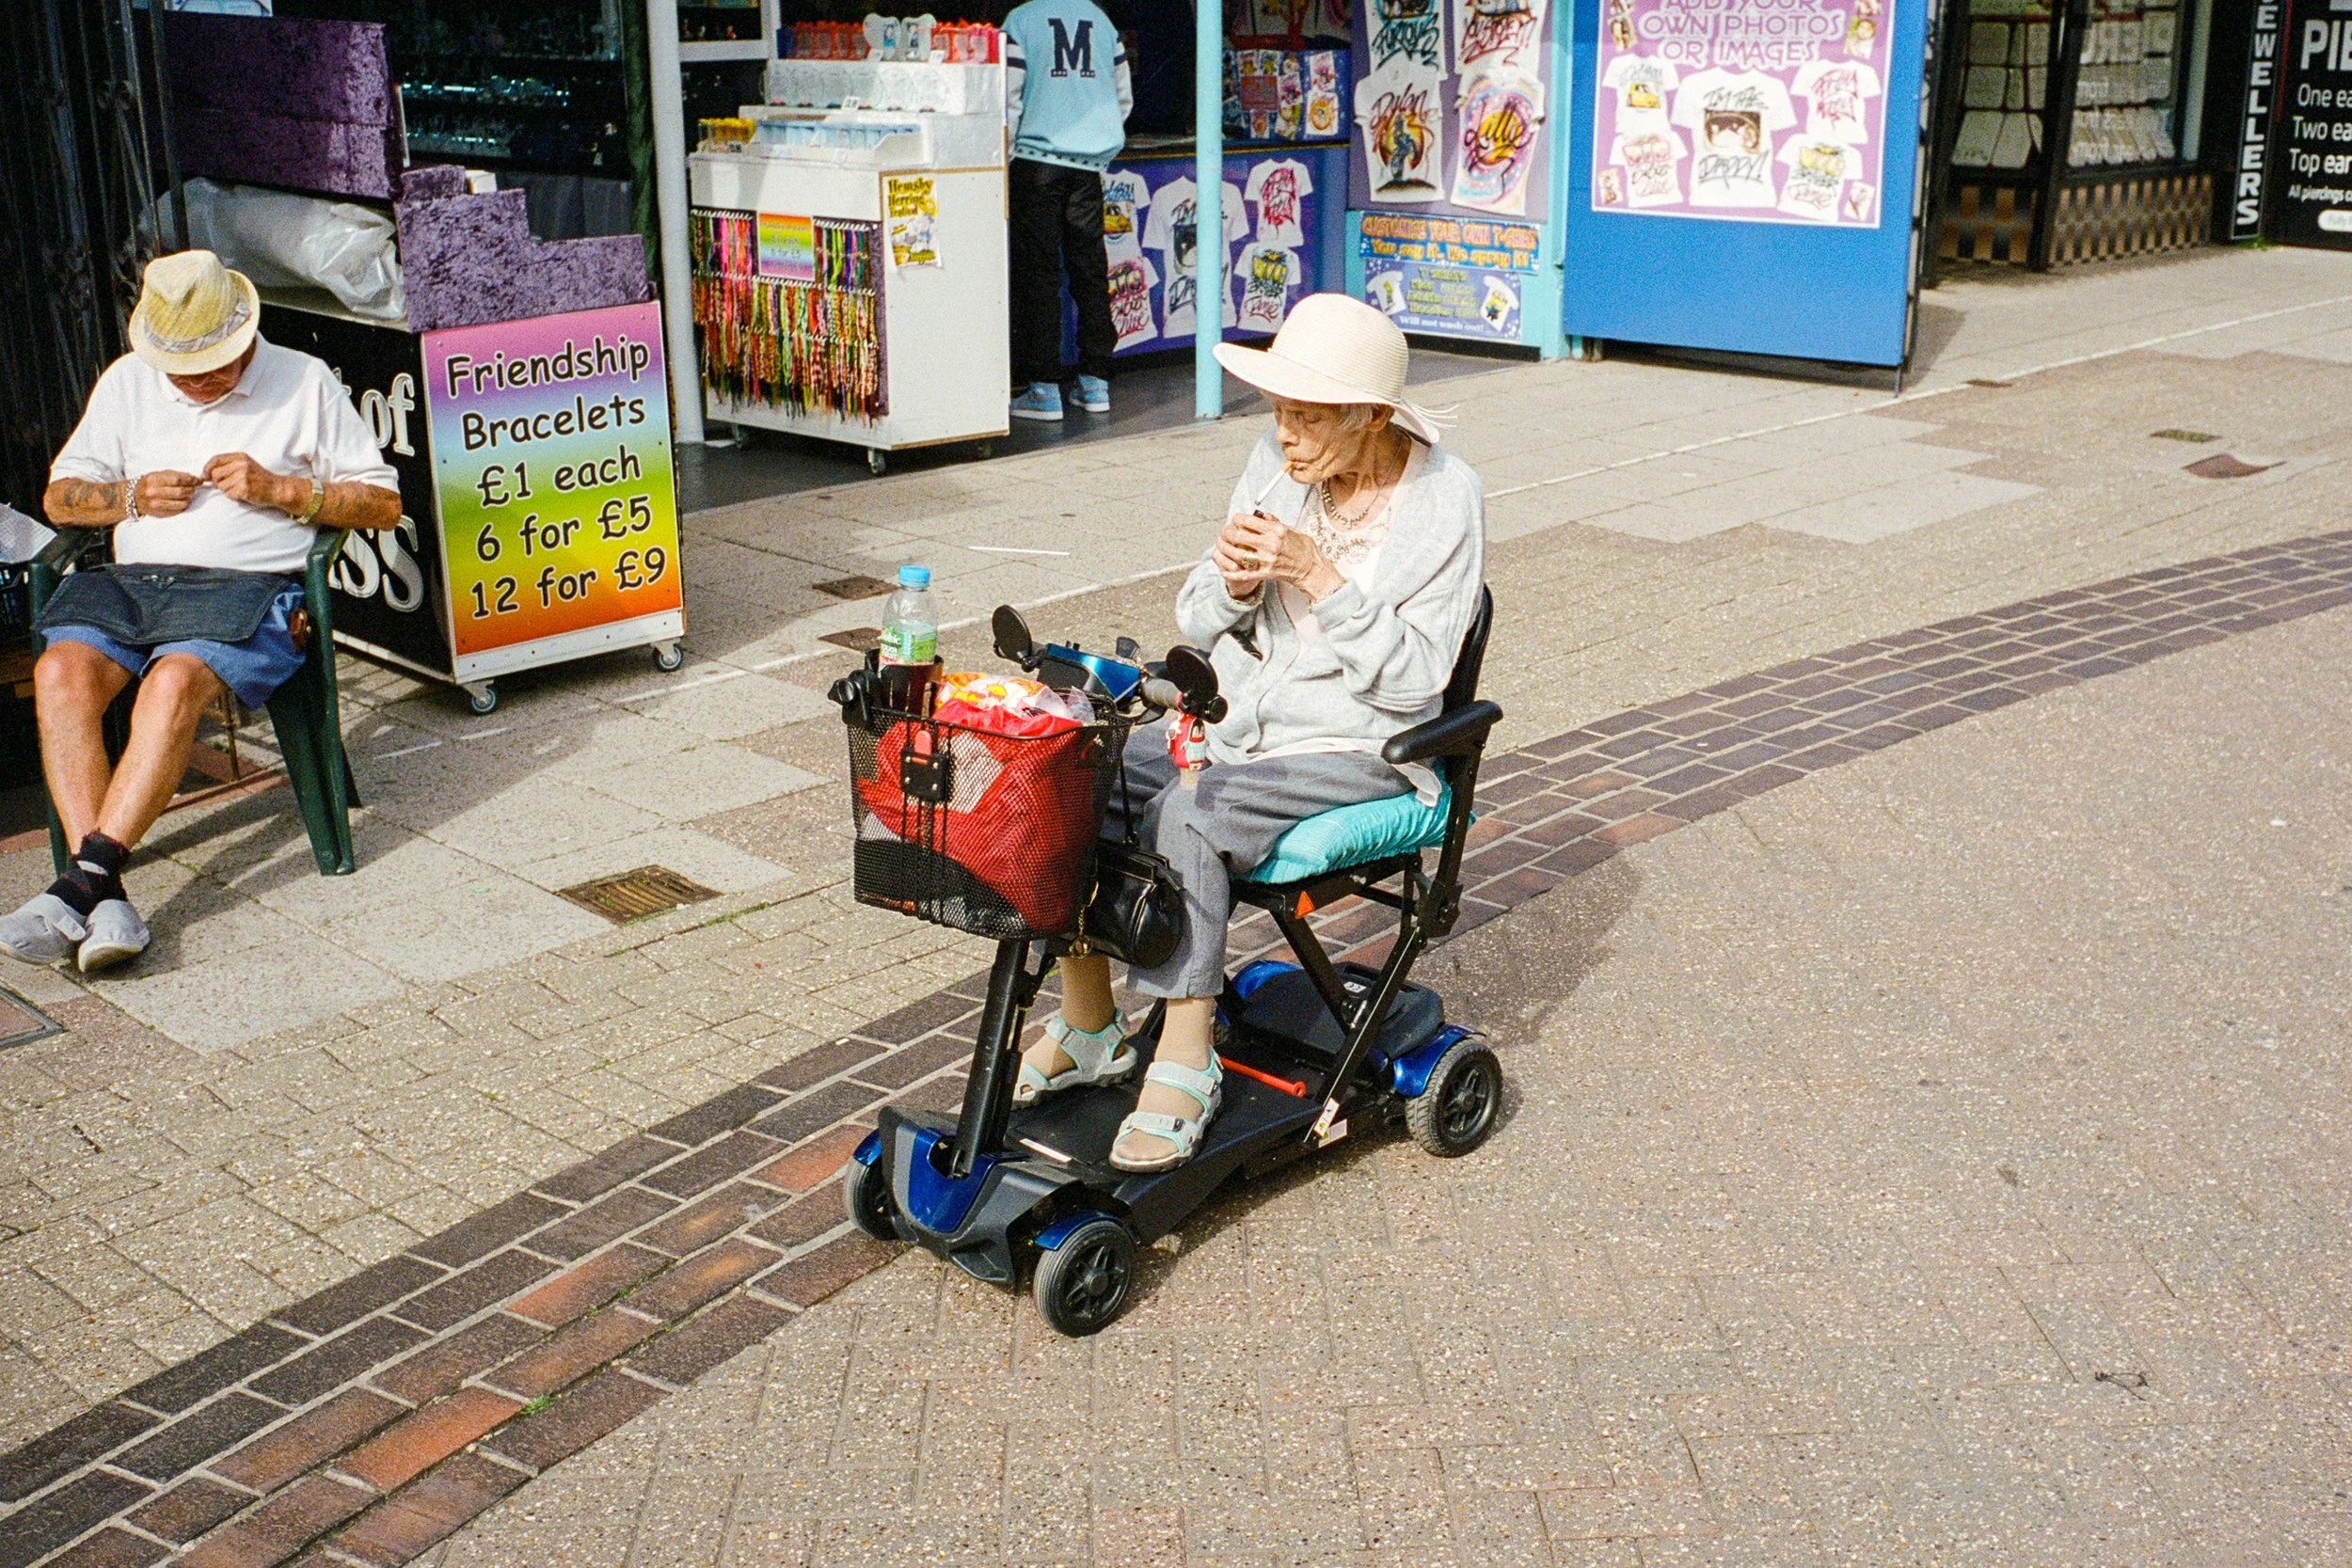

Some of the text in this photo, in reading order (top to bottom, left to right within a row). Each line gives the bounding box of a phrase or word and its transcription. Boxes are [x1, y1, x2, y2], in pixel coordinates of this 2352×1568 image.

[1047, 18, 1095, 77] M
[1644, 14, 1841, 36] OWN PHOTOS
[1663, 40, 1816, 63] OR IMAGES
[2236, 0, 2279, 226] EWELLERS
[2297, 83, 2332, 108] One
[2293, 116, 2328, 140] Two
[2288, 148, 2320, 178] Top
[447, 336, 649, 397] Friendship
[360, 372, 415, 456] of
[462, 395, 645, 451] Bracelets
[477, 445, 641, 507] £1 each
[477, 496, 651, 562] 6 for £5
[471, 546, 665, 618] 12 for £9
